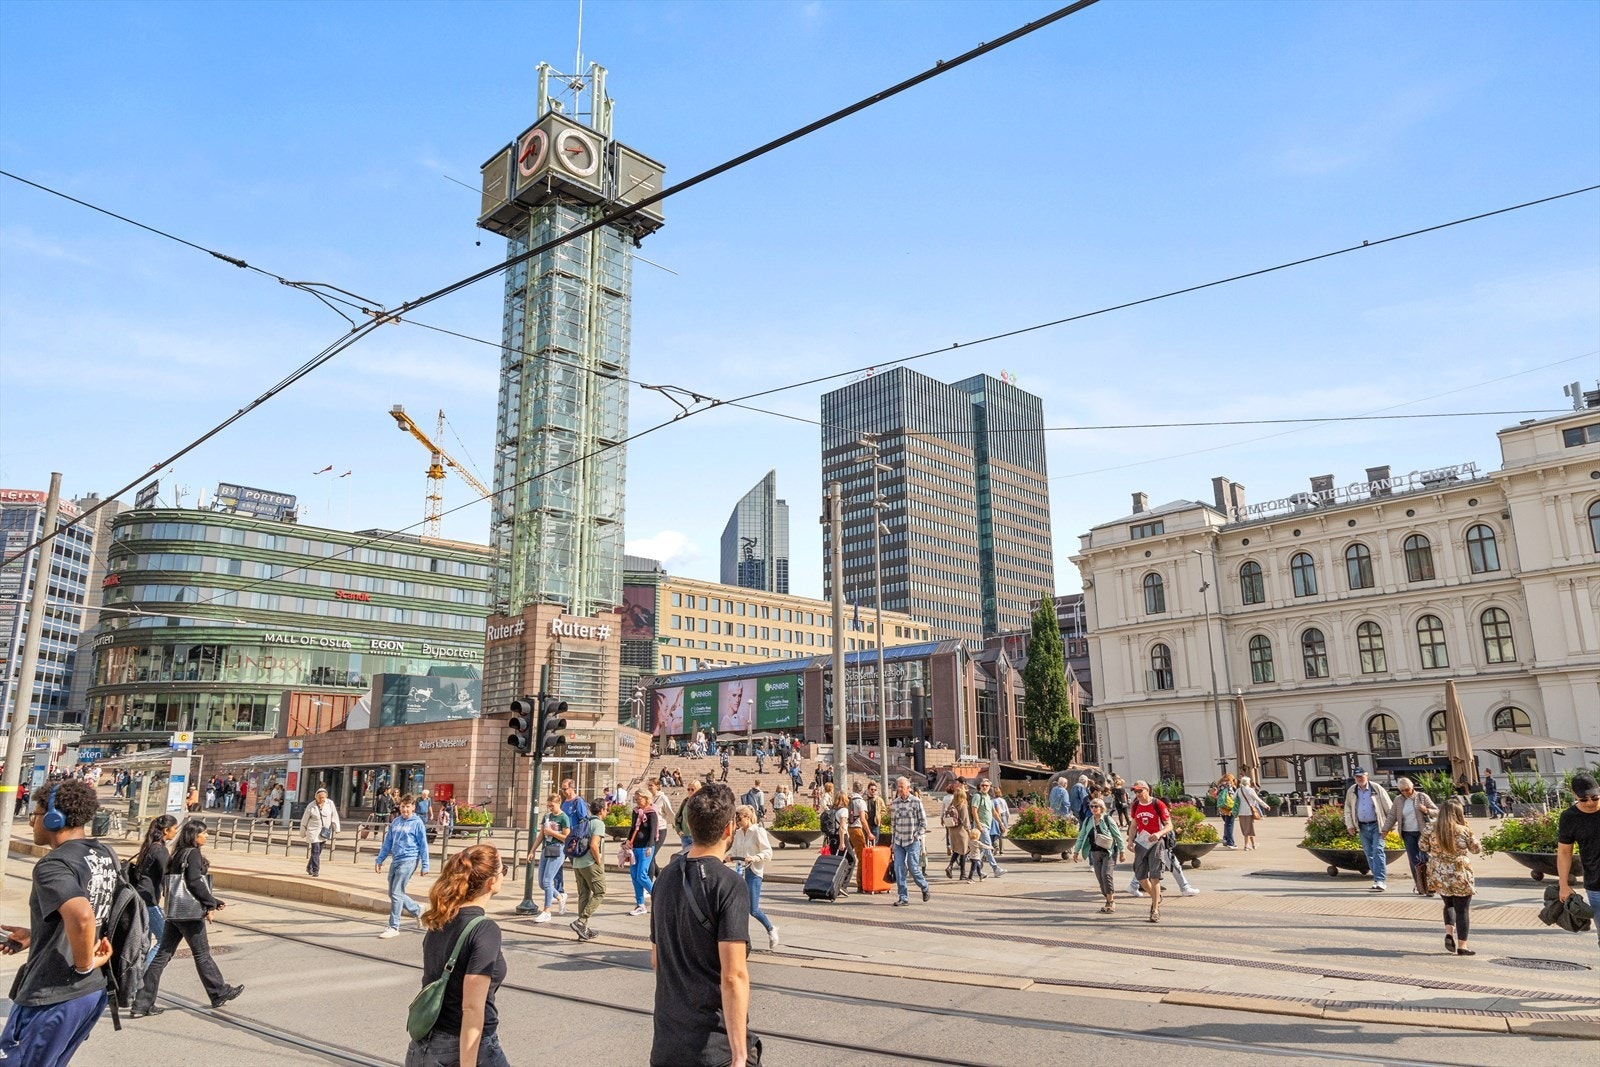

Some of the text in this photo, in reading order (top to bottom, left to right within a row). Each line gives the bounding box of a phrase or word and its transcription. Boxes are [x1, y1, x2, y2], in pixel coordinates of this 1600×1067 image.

[1229, 461, 1482, 521] COMFORT HOTEL GRAND CENTRAL
[335, 589, 373, 602] Scandic
[487, 618, 526, 641] Ruter#
[551, 618, 610, 641] Ruter#
[264, 633, 297, 645] MALL
[300, 635, 317, 646] OF
[370, 639, 405, 651] EGON
[224, 655, 303, 672] LINDEX
[859, 668, 905, 680] Sentrtasjon
